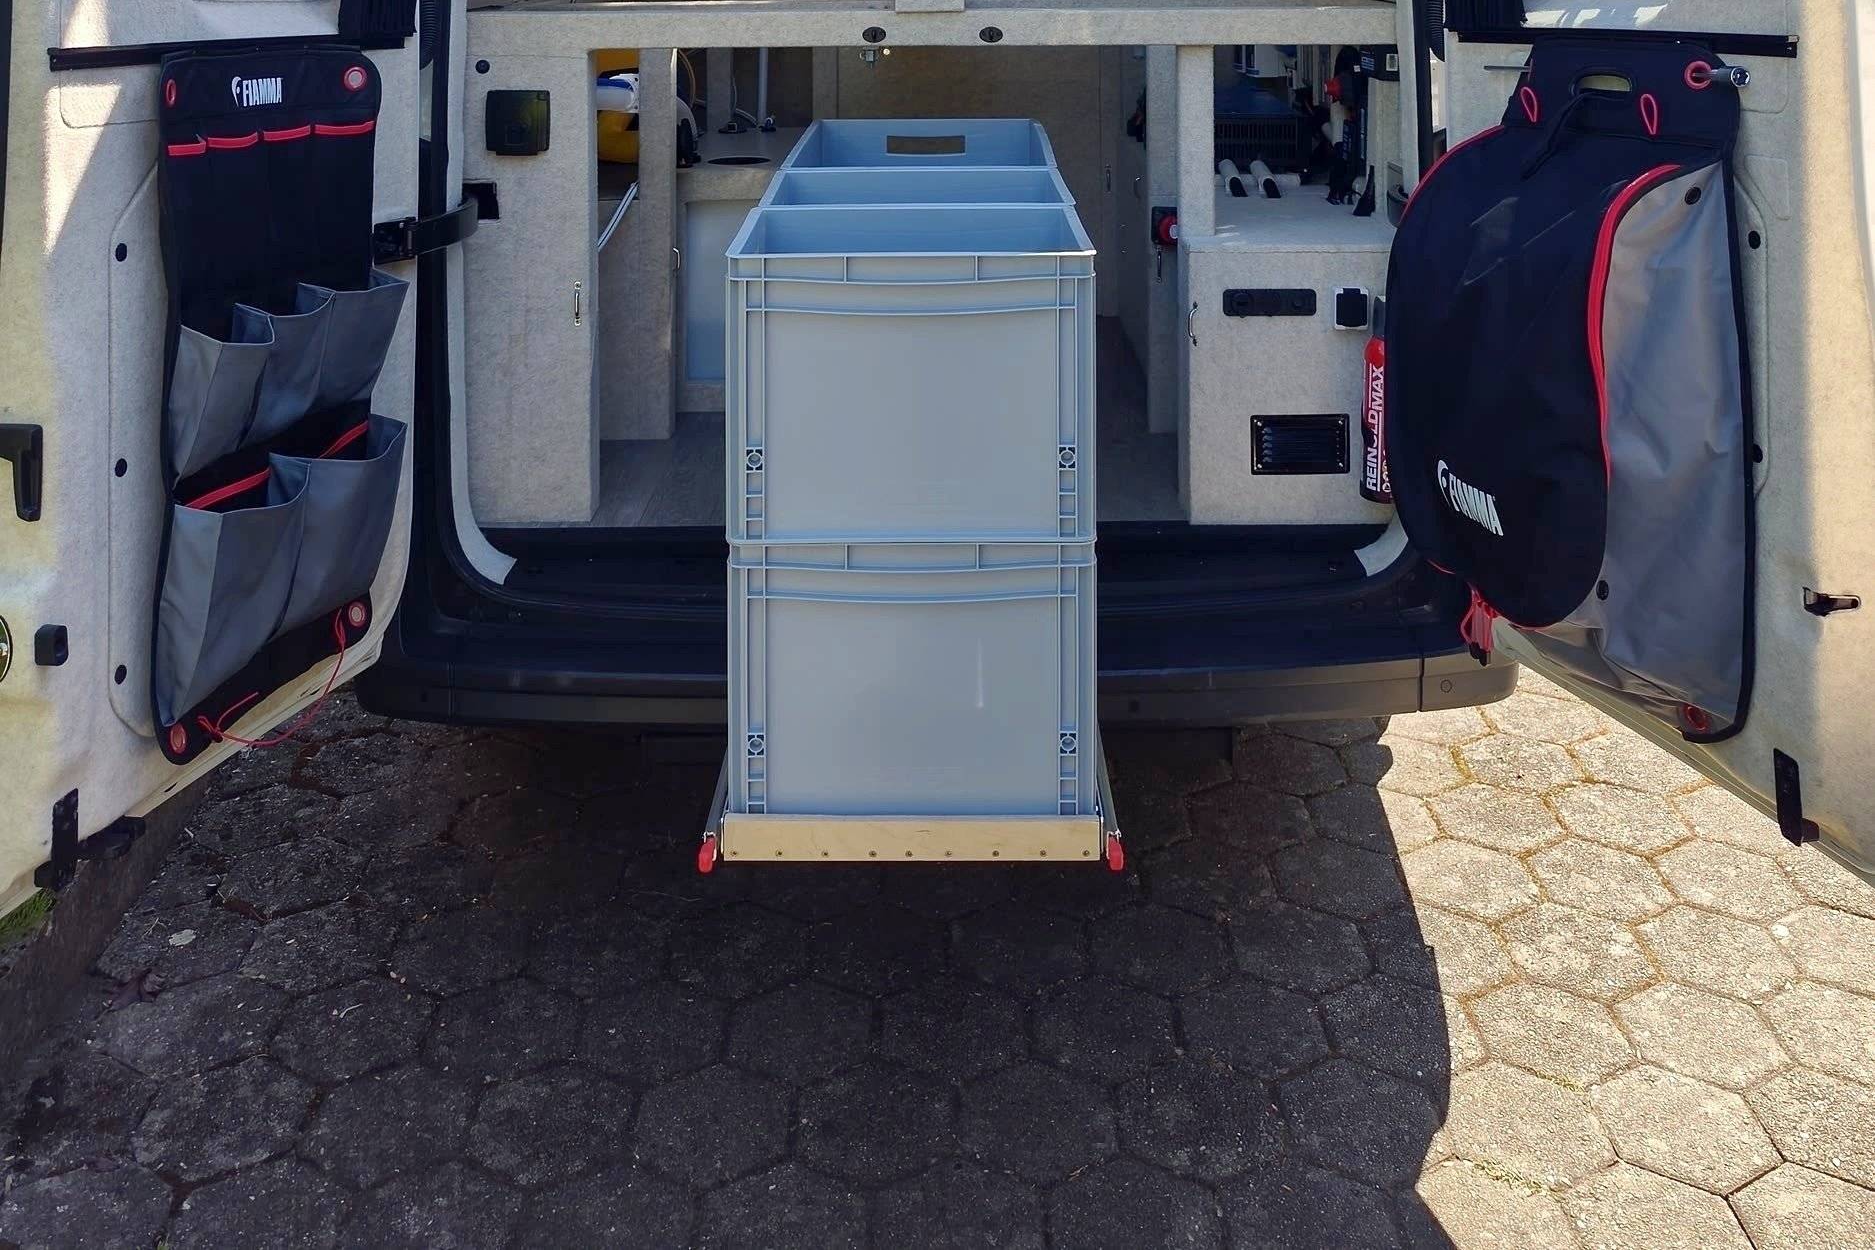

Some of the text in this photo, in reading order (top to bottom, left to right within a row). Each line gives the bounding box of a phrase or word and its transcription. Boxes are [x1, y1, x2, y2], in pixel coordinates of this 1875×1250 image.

[242, 77, 282, 107] FIAMMA
[1366, 365, 1385, 491] REINLDMAX
[1448, 472, 1504, 536] FIAMMA
